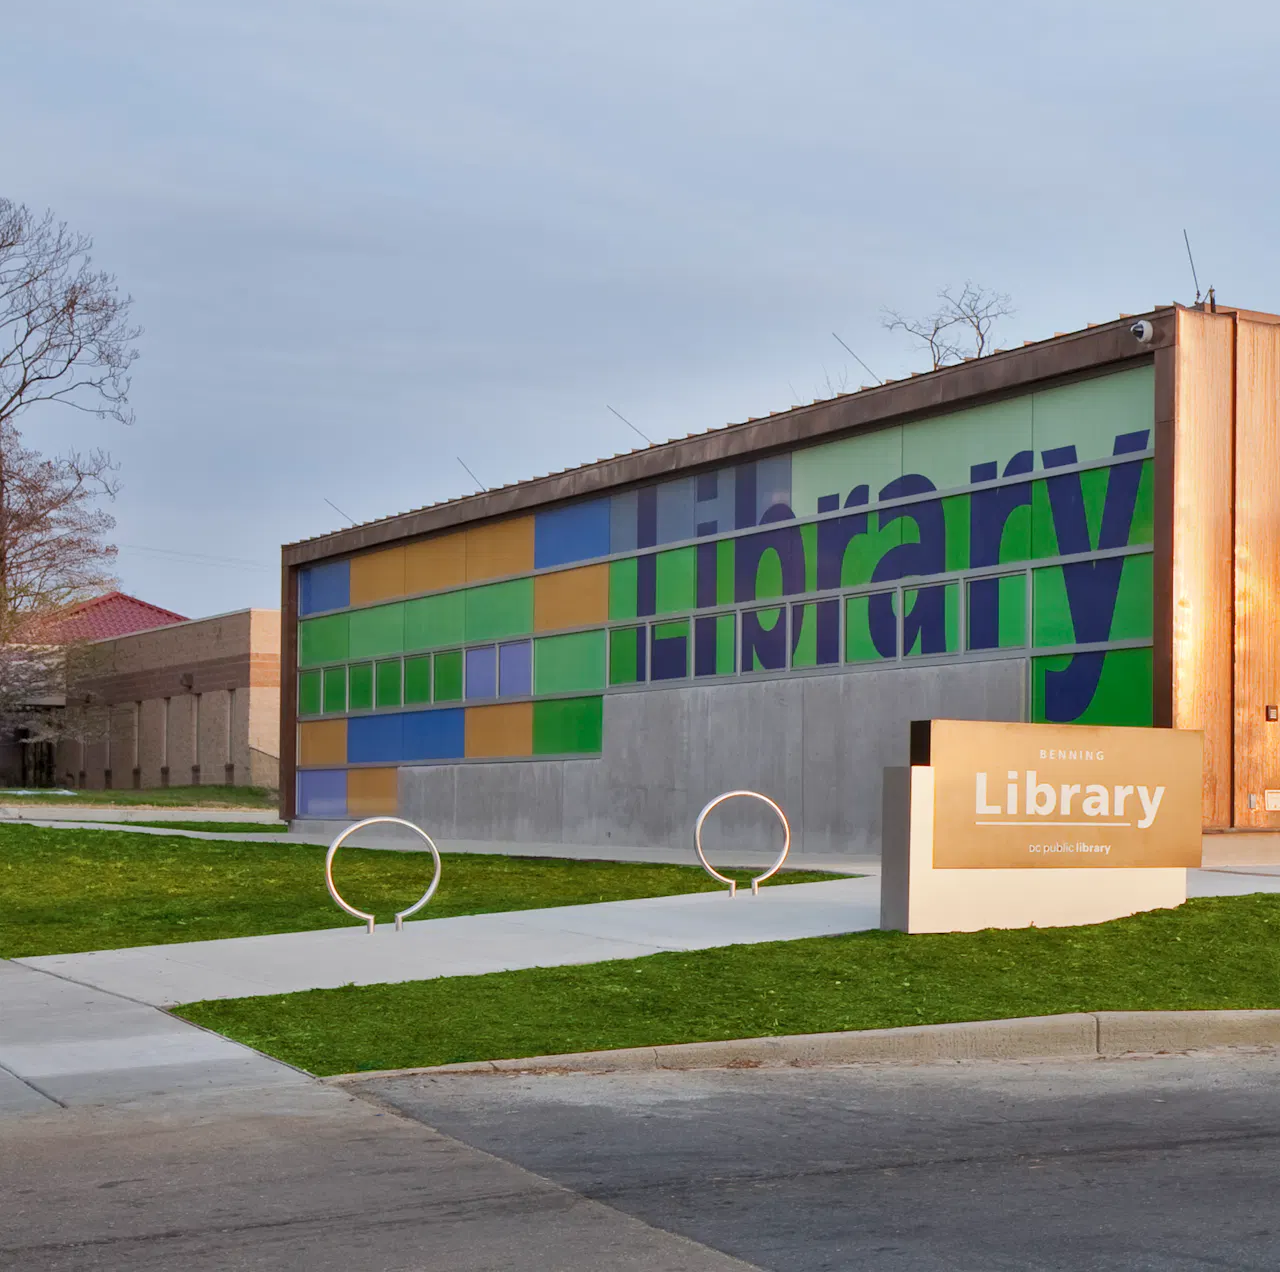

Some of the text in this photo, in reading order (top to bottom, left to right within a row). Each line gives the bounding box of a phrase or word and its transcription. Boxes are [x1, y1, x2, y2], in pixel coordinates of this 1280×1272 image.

[636, 429, 1151, 723] Library
[1039, 748, 1105, 761] BENNING
[974, 770, 1166, 829] Library
[1043, 841, 1075, 856] public
[1075, 841, 1112, 856] library
